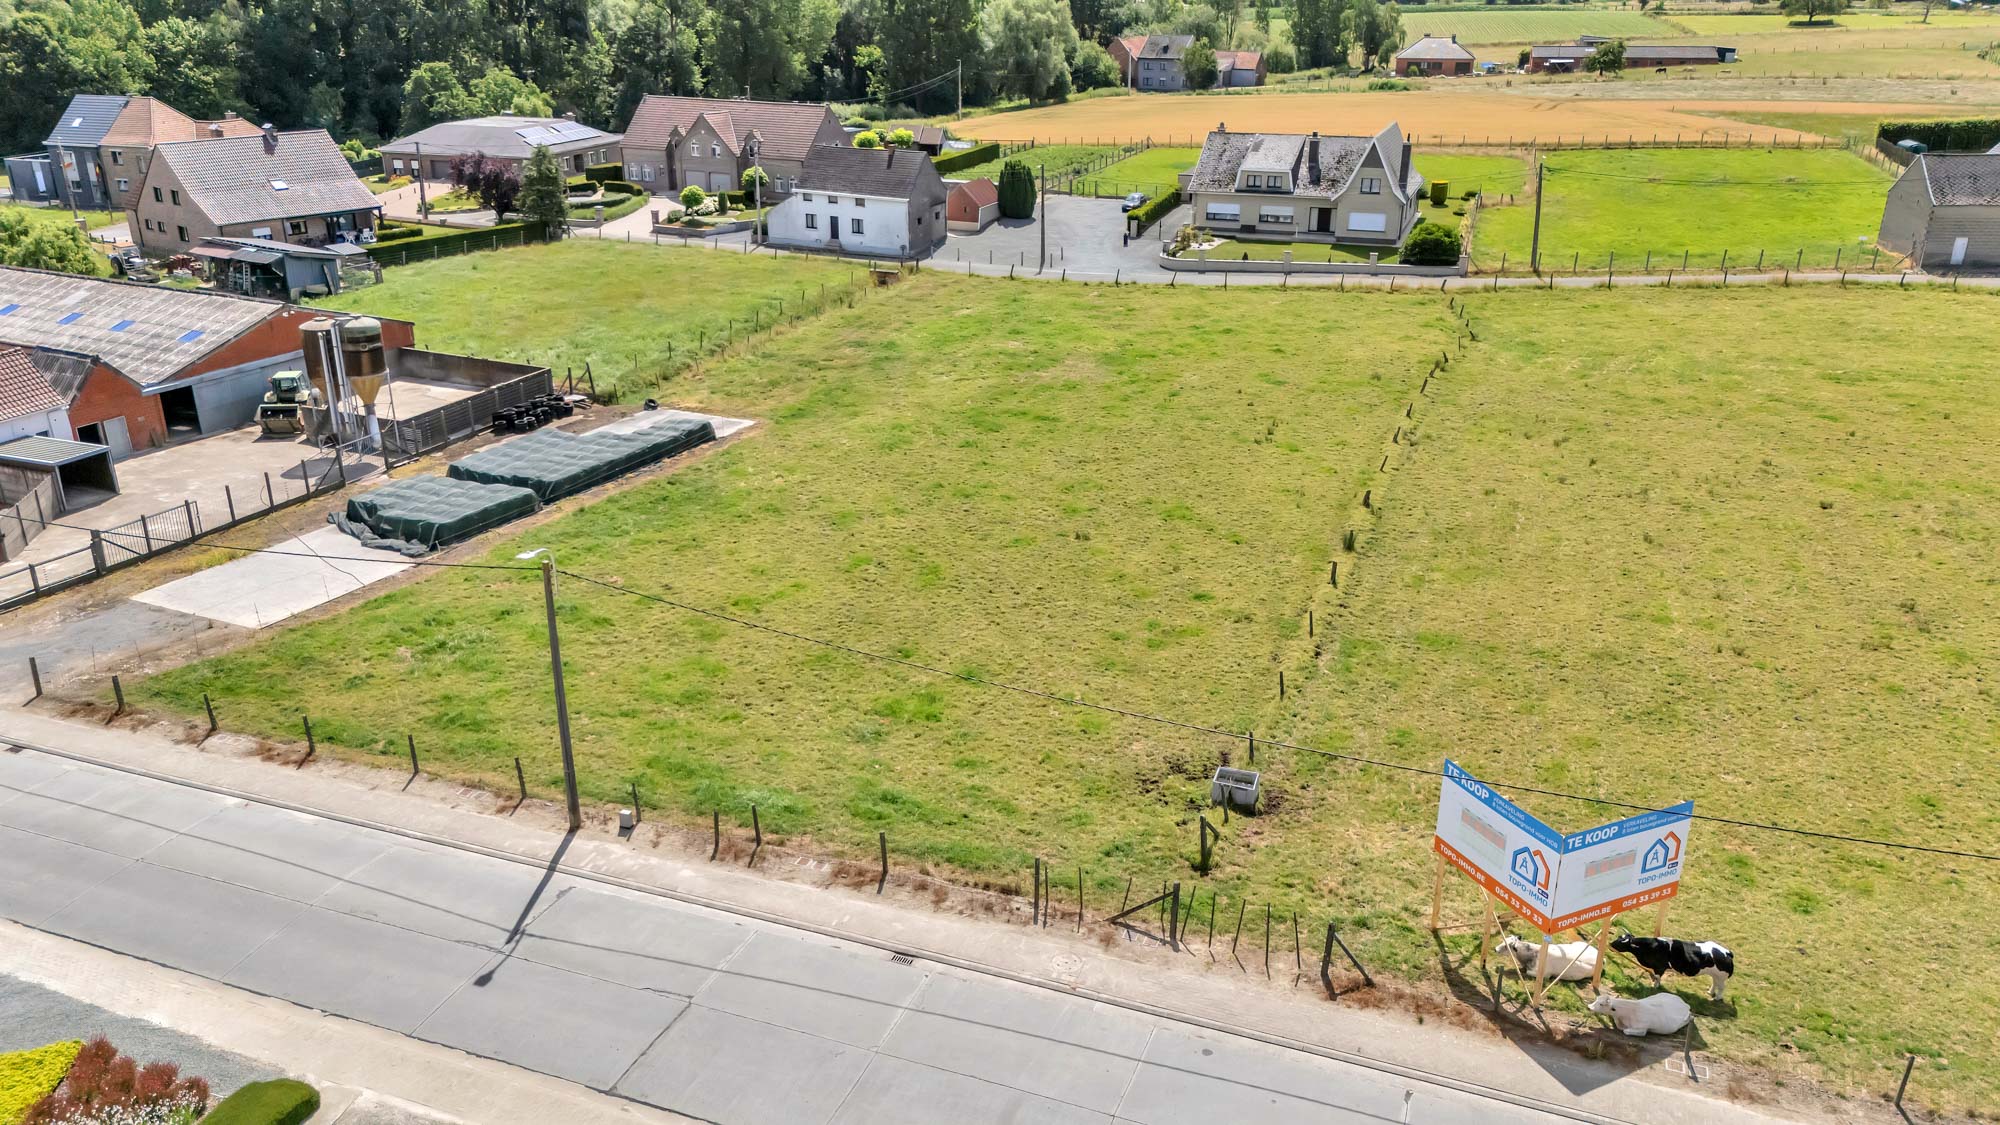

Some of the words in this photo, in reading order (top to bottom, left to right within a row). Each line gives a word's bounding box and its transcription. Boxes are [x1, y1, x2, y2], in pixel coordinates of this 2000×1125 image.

[1447, 764, 1460, 780] TE
[1461, 774, 1489, 800] KOOP
[1568, 836, 1583, 849] TE
[1585, 826, 1618, 844] KOOP
[1440, 844, 1486, 884] TOPO-IMMO.BE
[1637, 869, 1678, 885] TOPO-IMMO
[1508, 875, 1548, 907] TOPO-IMMO
[1622, 898, 1636, 908] 054
[1639, 894, 1649, 903] 33
[1650, 891, 1660, 900] 39
[1661, 888, 1672, 896] 33
[1496, 886, 1508, 900] 054
[1510, 898, 1520, 908] 33
[1522, 906, 1531, 915] 39
[1533, 914, 1543, 924] 33
[1557, 906, 1612, 928] TOPO-IMMO.BE
